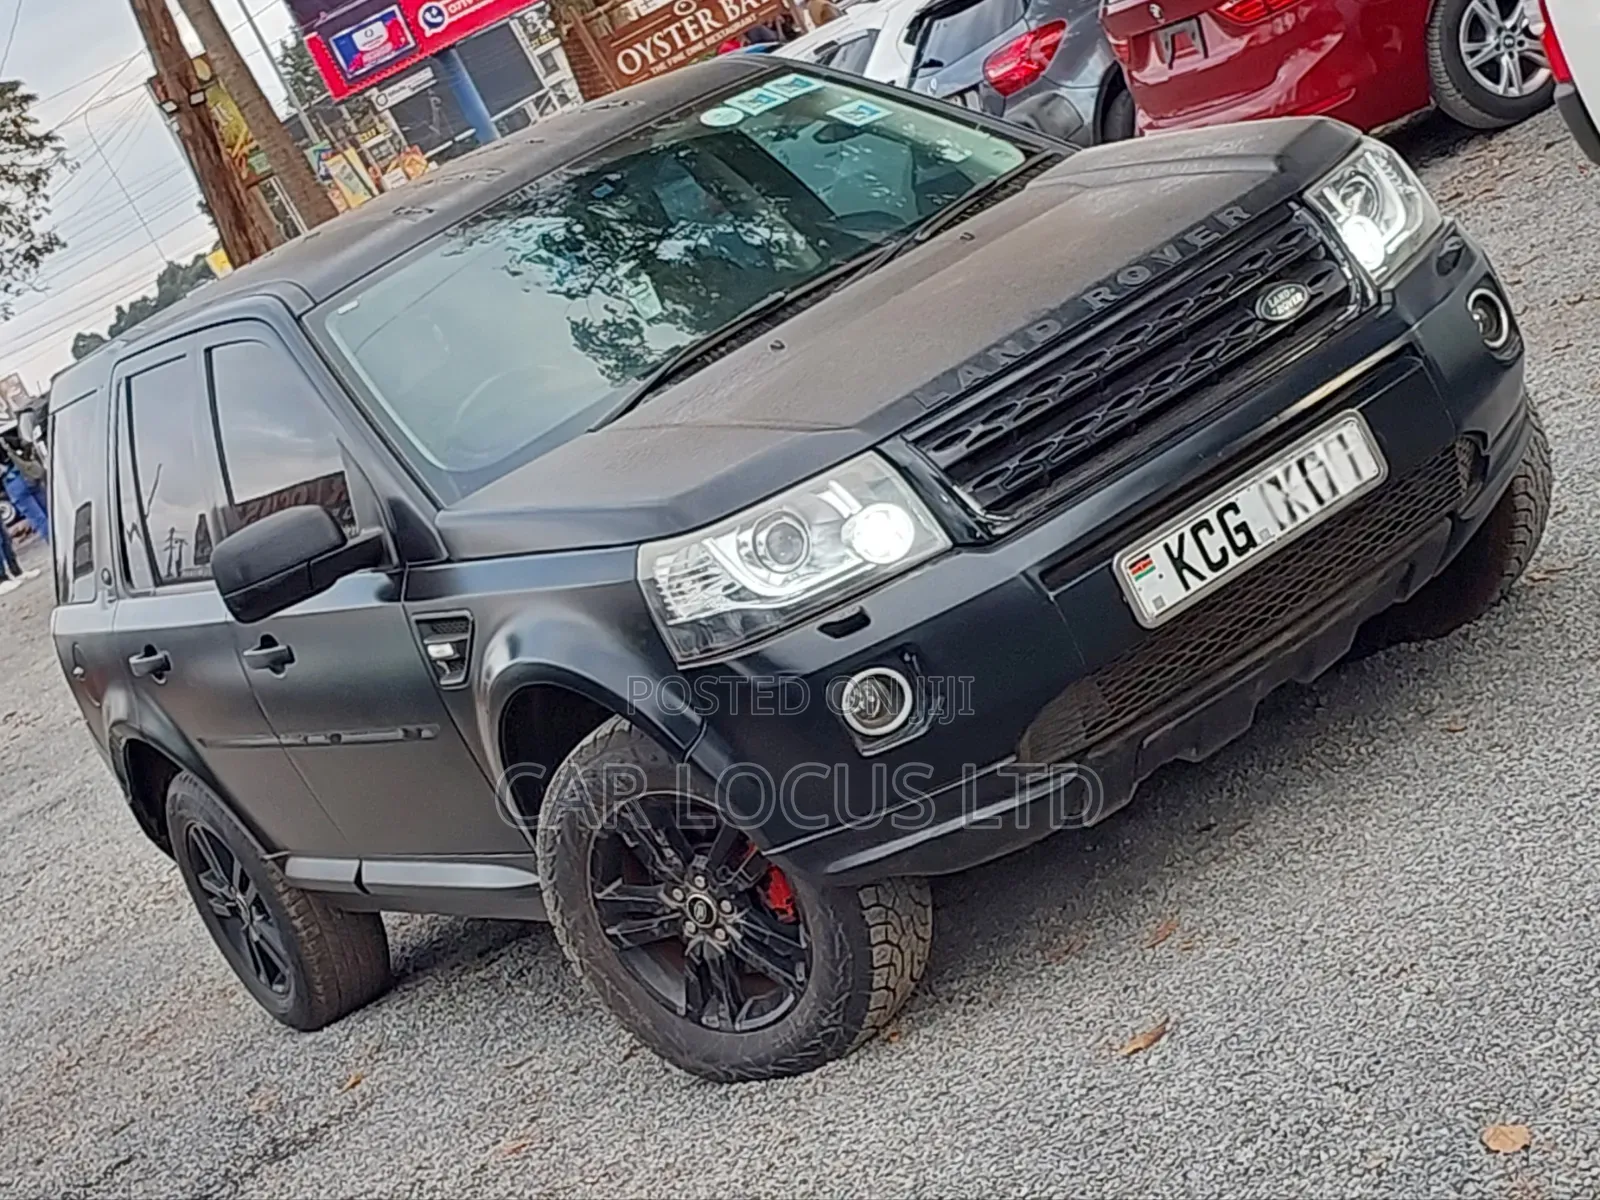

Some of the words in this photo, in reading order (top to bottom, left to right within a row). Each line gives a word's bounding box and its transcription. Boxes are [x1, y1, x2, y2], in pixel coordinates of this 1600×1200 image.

[617, 7, 724, 76] OYSTER
[720, 0, 769, 22] BA
[650, 60, 667, 75] THE
[706, 13, 758, 46] RESTAURANT
[910, 318, 1064, 411] LAND
[1081, 205, 1253, 312] ROVER
[1267, 288, 1291, 309] LAND
[1276, 292, 1305, 315] ROVER
[1164, 501, 1258, 592] KCG
